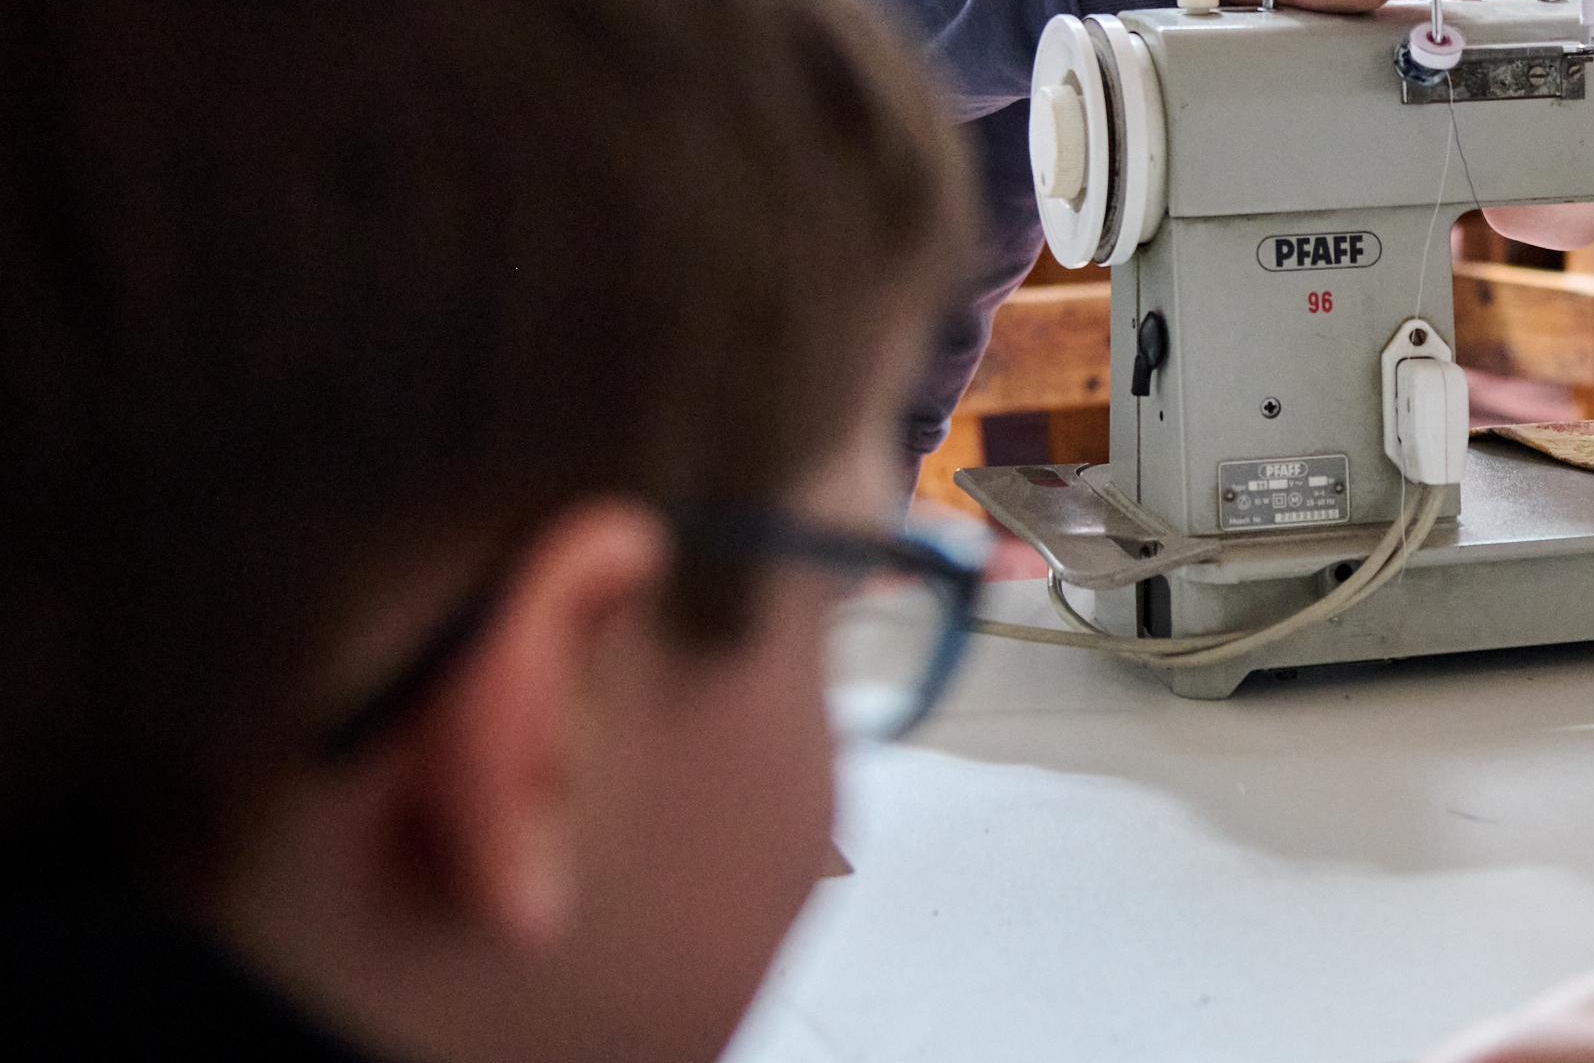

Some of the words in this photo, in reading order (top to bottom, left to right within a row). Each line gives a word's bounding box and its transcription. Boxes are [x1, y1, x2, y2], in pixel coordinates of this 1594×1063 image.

[1275, 235, 1364, 267] PFAFF
[1308, 291, 1333, 313] 96
[1266, 463, 1301, 477] PFAFF
